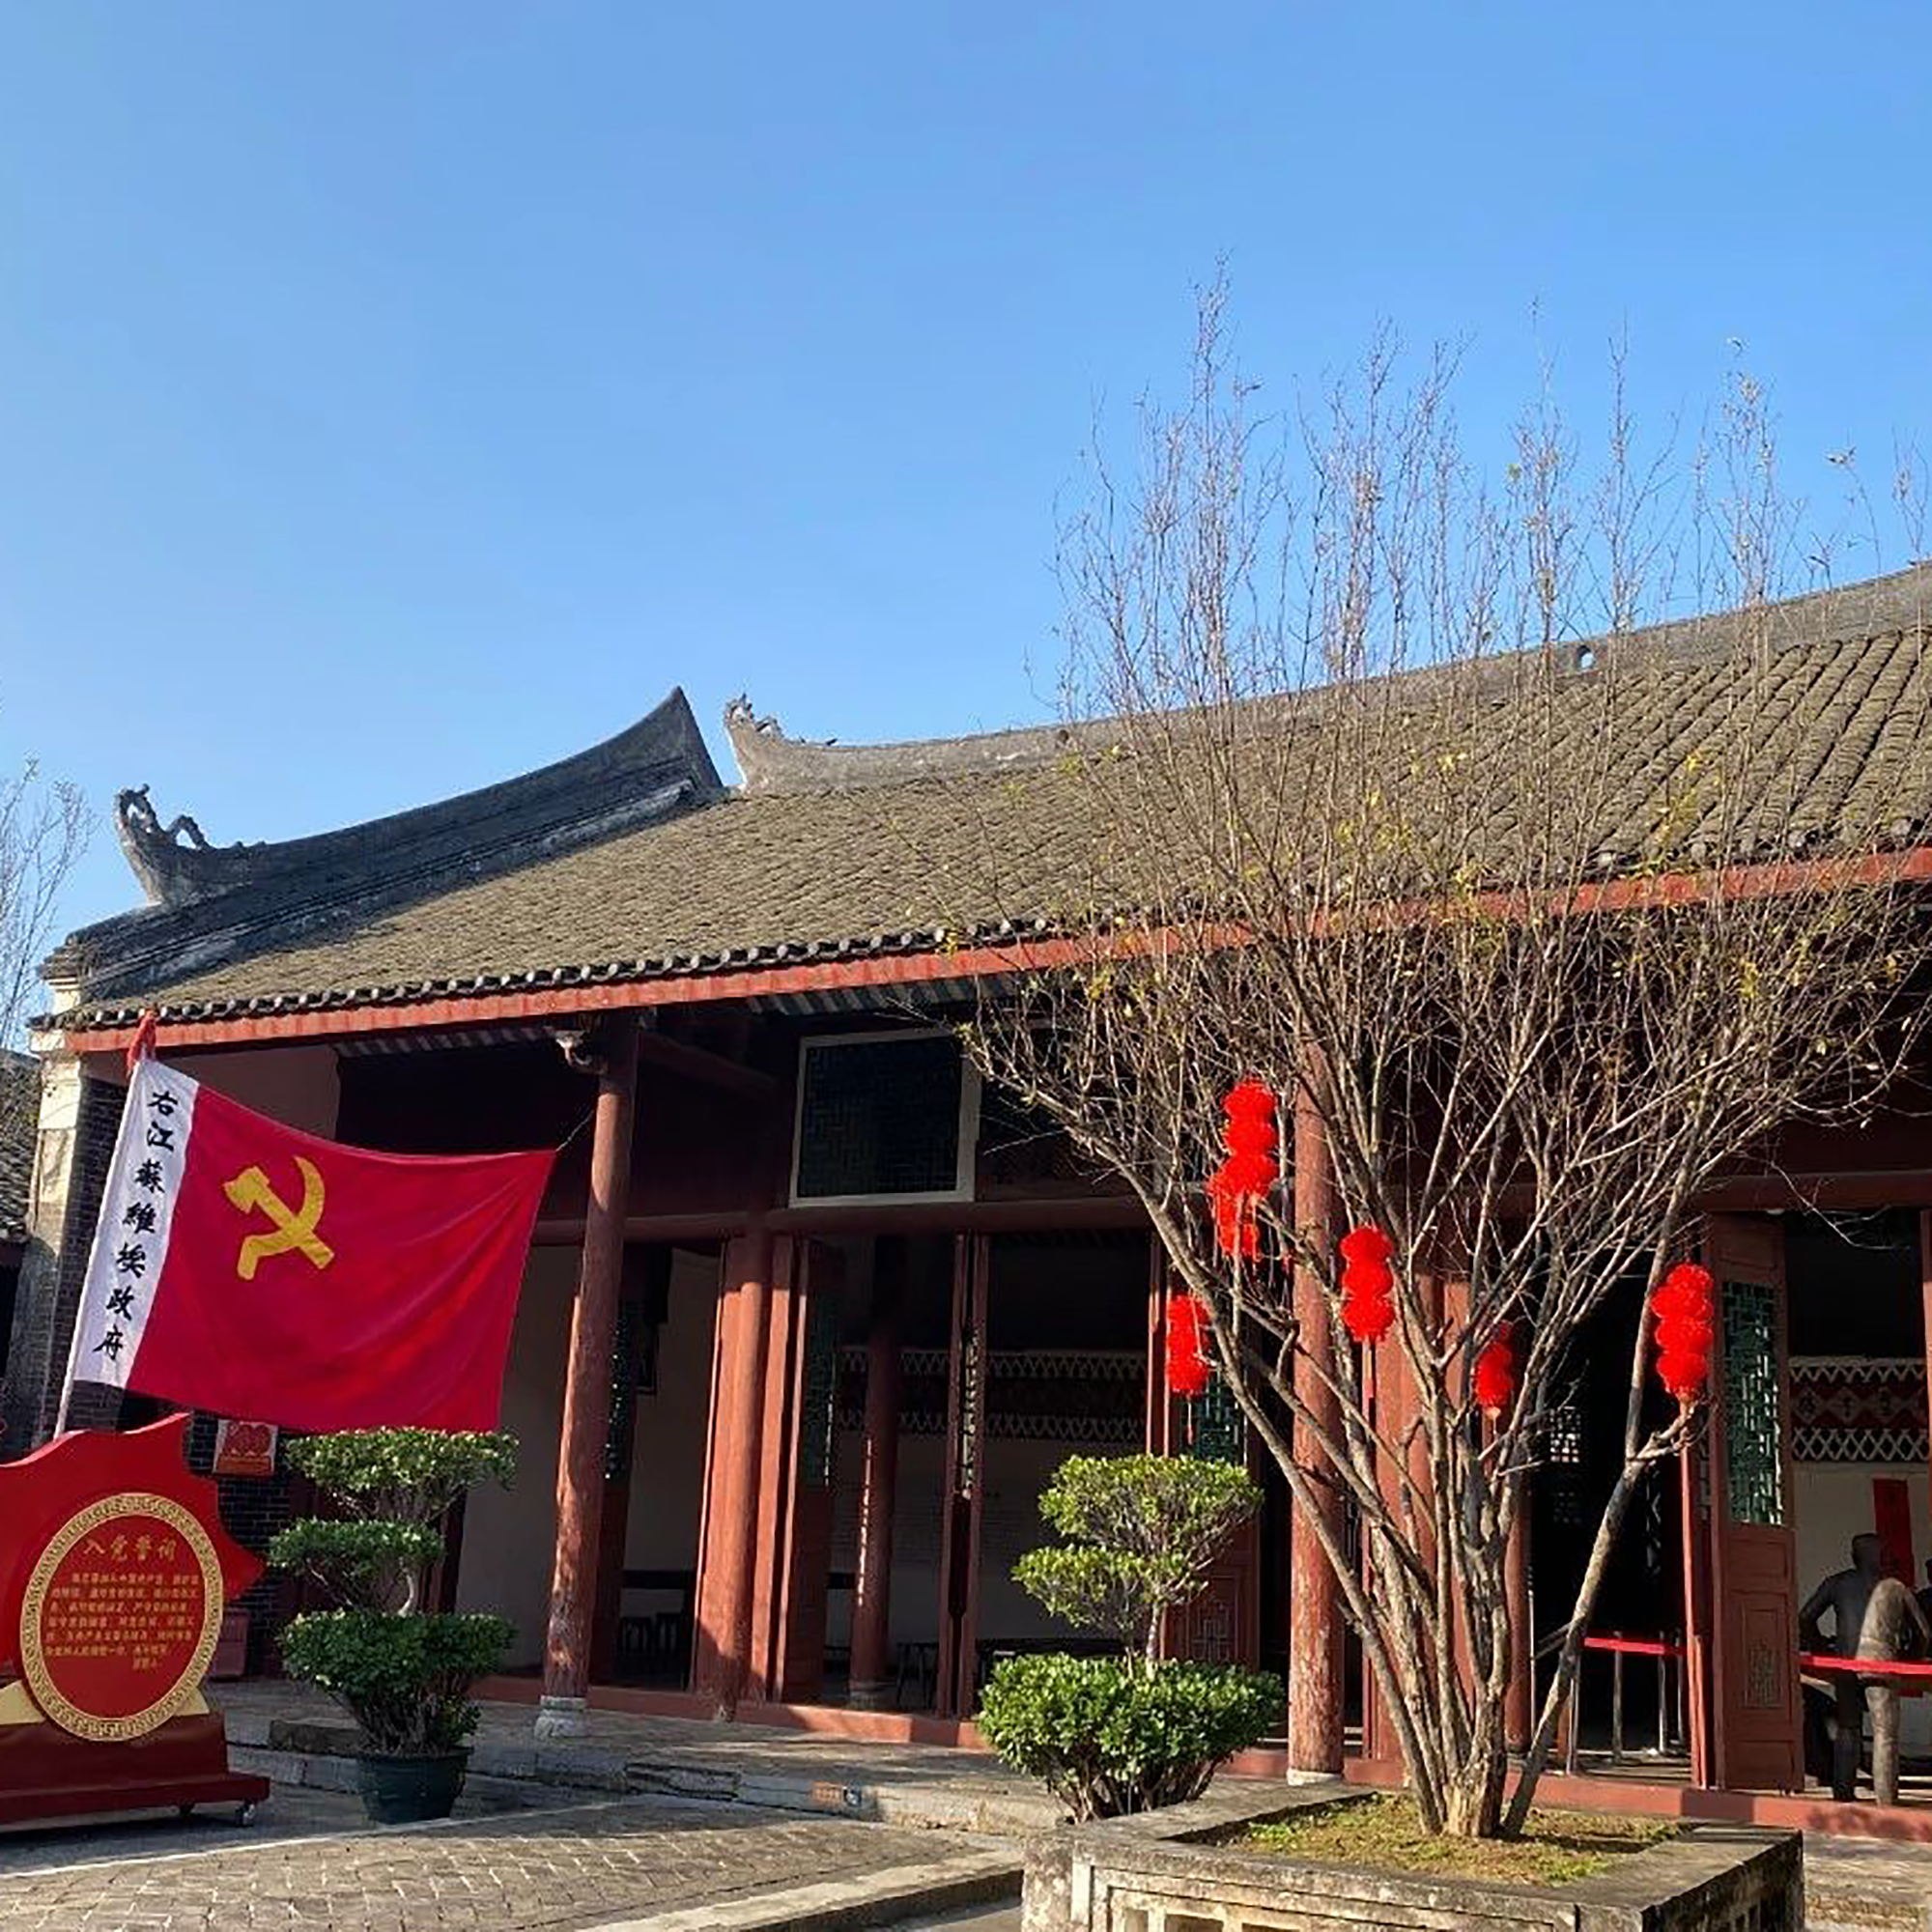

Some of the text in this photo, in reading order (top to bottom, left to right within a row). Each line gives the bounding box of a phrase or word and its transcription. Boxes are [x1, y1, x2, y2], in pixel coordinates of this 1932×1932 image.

[93, 1091, 178, 1360] 右江蘇維埃政府
